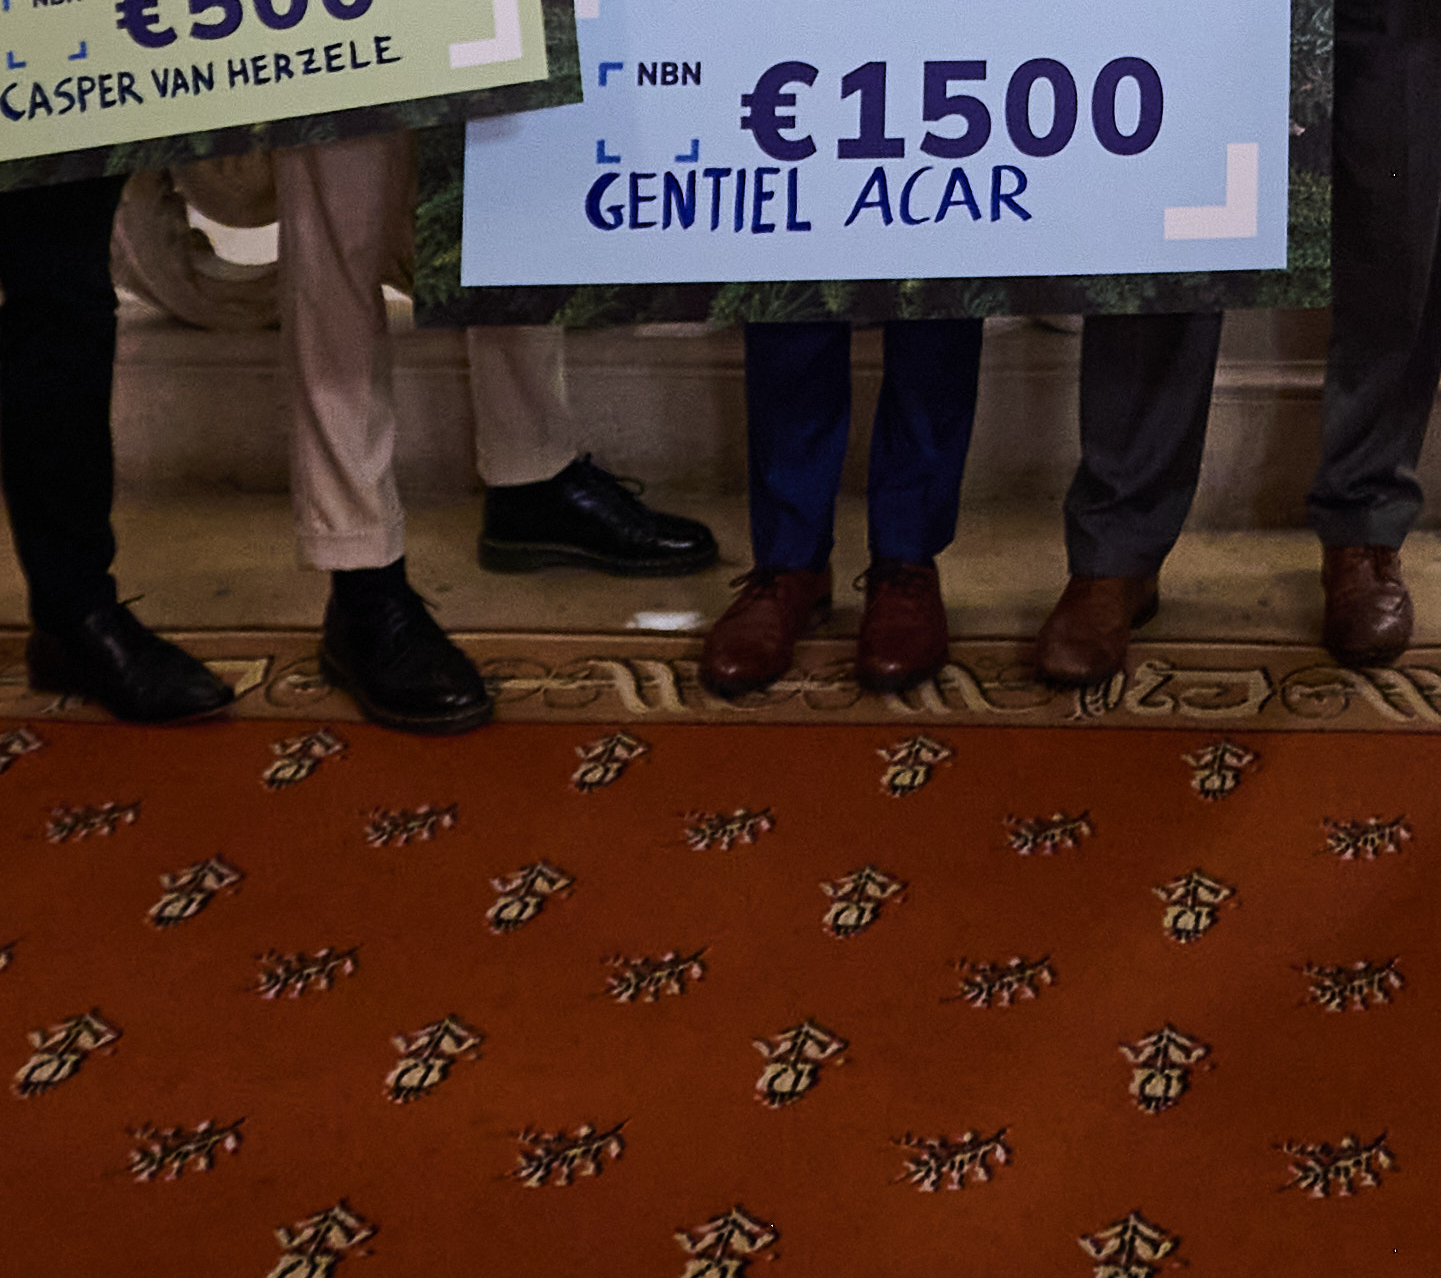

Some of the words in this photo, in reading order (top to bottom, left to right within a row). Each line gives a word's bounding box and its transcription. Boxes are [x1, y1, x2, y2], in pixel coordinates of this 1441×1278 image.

[0, 73, 143, 121] CASPER
[151, 62, 214, 98] VAN
[229, 35, 402, 86] HERZELE
[636, 62, 702, 86] NBN
[740, 56, 1165, 161] €1500
[584, 167, 812, 234] GENTIEL
[844, 164, 1034, 225] ACAR
